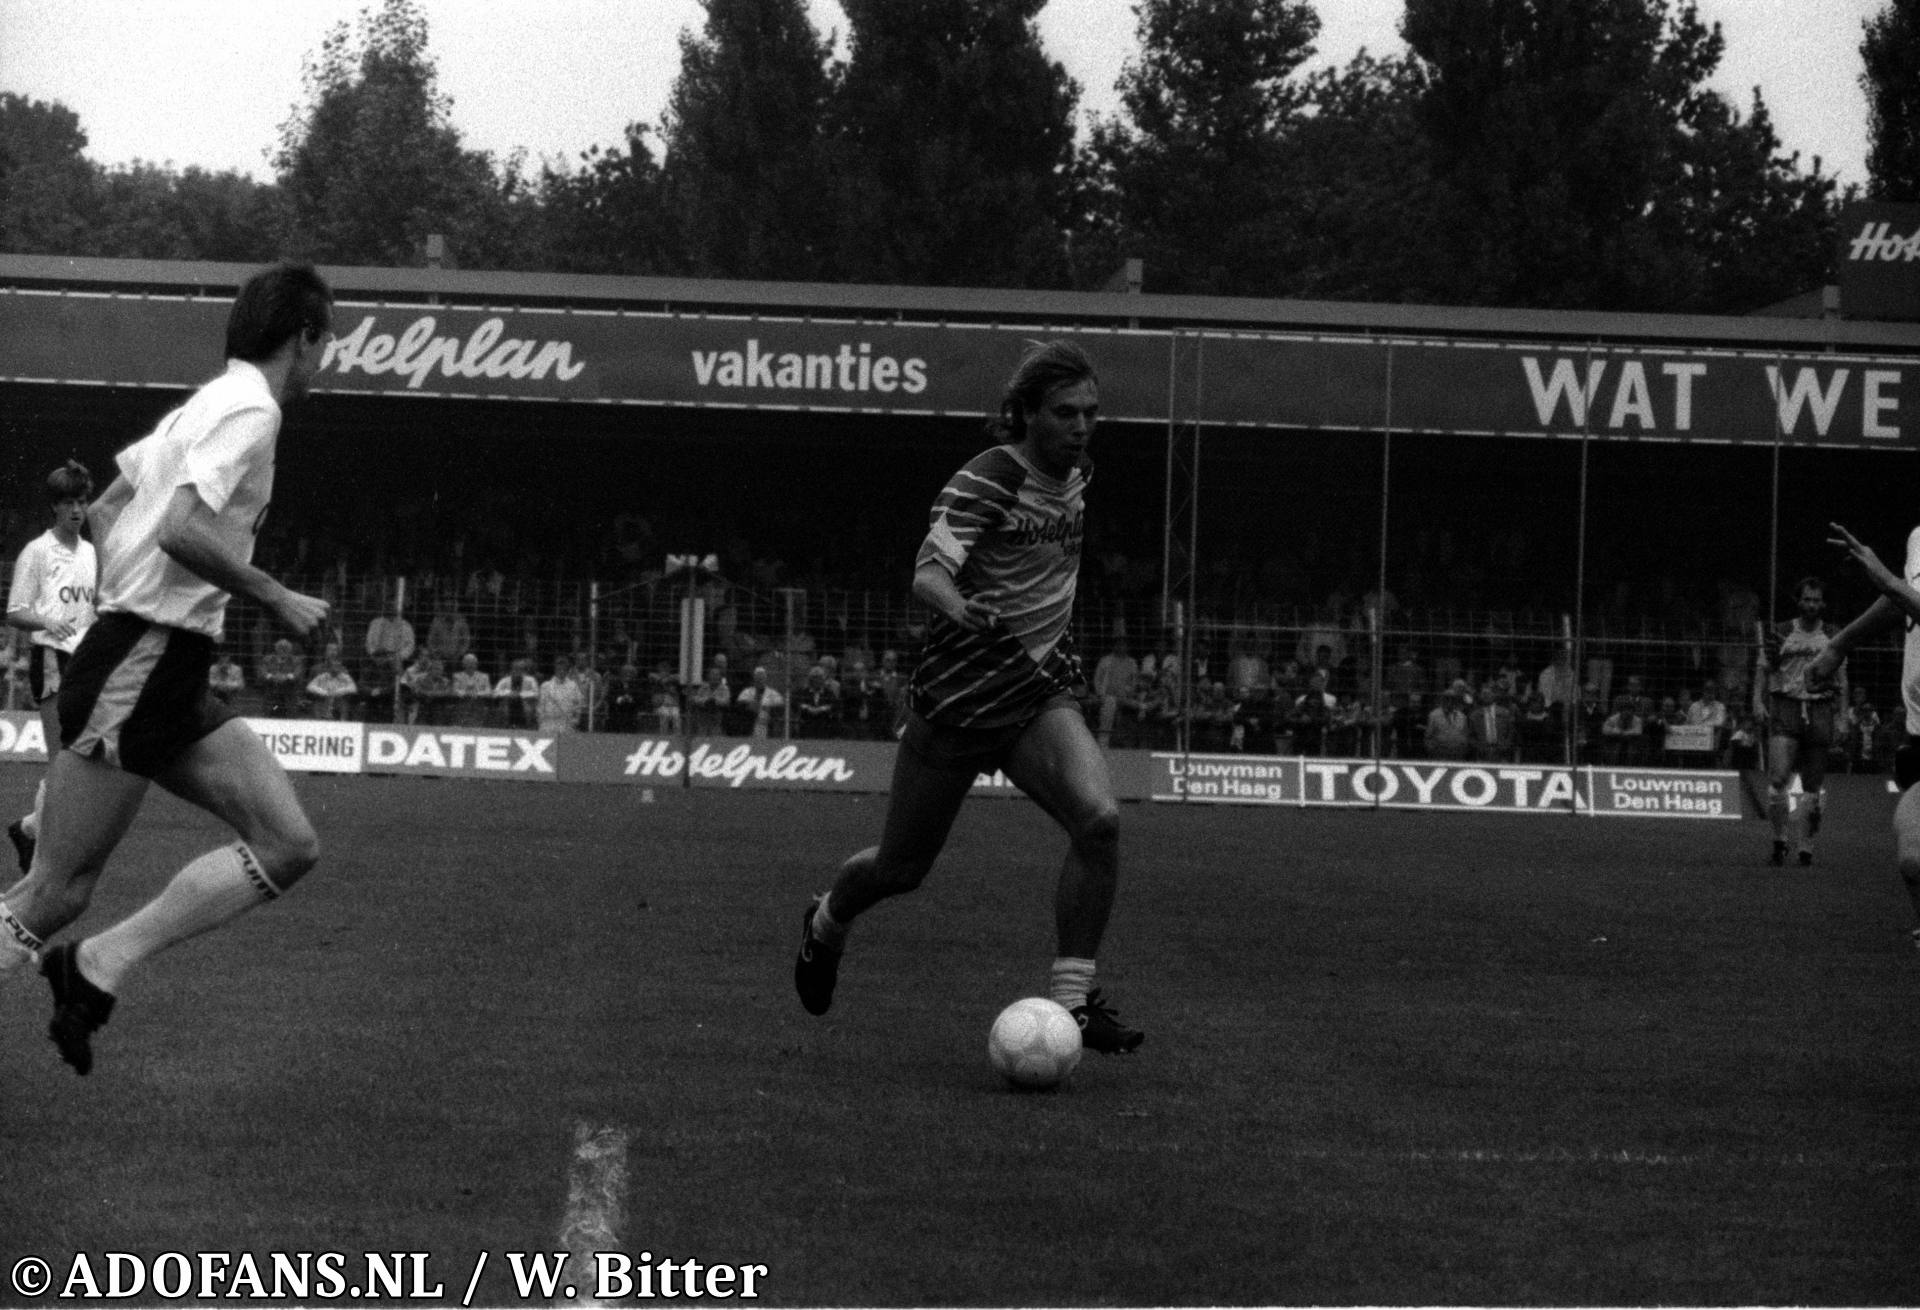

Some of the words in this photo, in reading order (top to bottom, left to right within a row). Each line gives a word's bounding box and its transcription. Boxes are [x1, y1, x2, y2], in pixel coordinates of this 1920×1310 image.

[319, 316, 585, 389] telplan
[691, 339, 928, 394] vakanties
[1521, 356, 1707, 430] WAT
[1765, 365, 1901, 438] WE
[260, 733, 355, 757] TISERING
[367, 731, 555, 773] DATEX
[624, 740, 854, 788] Hotelplan
[1169, 758, 1283, 779] Louwman
[1222, 779, 1282, 800] Haag
[1305, 763, 1588, 808] TOYOTA
[1611, 773, 1723, 794] Louwman
[1614, 792, 1659, 810] Den
[1664, 794, 1722, 817] Haag
